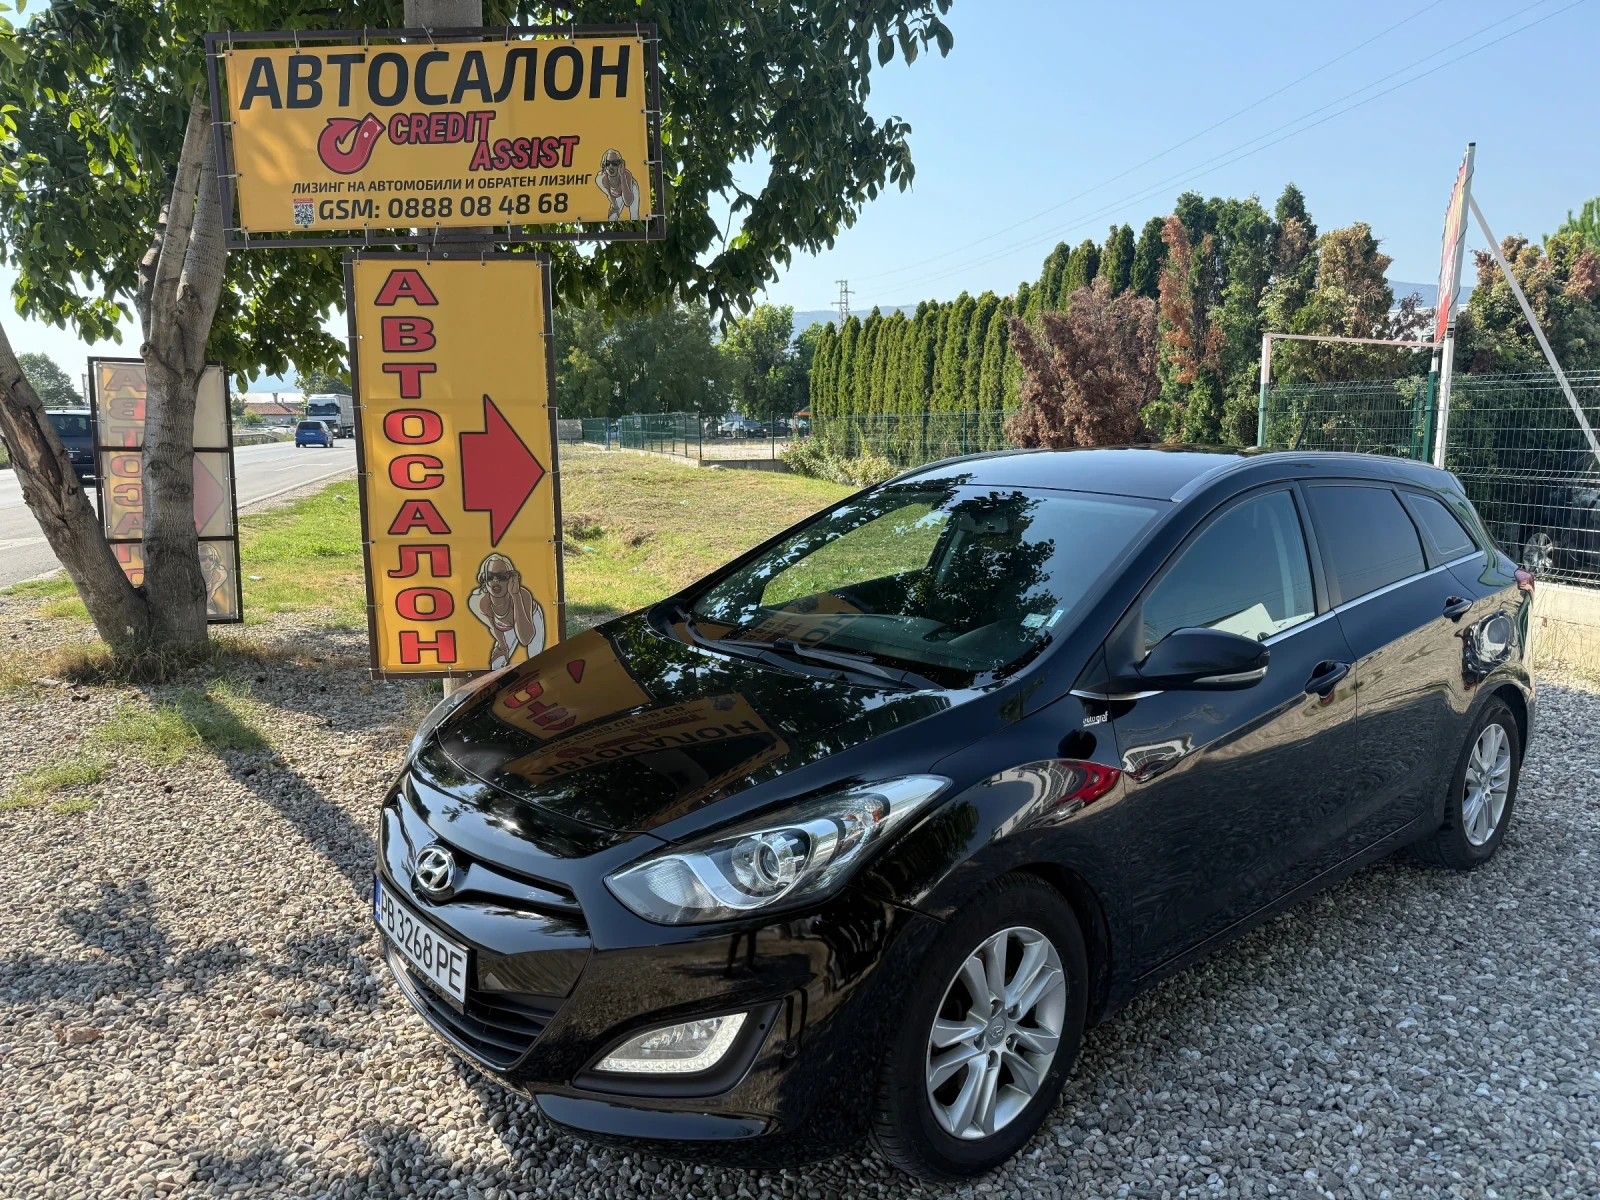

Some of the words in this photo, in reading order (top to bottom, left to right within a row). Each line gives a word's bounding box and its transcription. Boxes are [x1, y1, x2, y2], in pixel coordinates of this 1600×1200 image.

[239, 44, 631, 110] АВТОСАЛОН
[388, 110, 496, 145] CREDIT
[469, 135, 580, 171] ASSIST
[292, 180, 345, 194] ЛИЗИНГ
[347, 181, 365, 193] НА
[368, 178, 463, 192] АВТОМОБИЛИ
[465, 178, 475, 190] И
[477, 175, 536, 189] ОБРАТЕН
[539, 173, 592, 187] ЛИЗИНГ
[318, 198, 381, 220] GSM:
[388, 196, 453, 219] 0888
[460, 195, 492, 217] 08
[498, 193, 531, 215] 48
[537, 192, 569, 214] 68
[373, 268, 458, 664] АВТОСАЛОН
